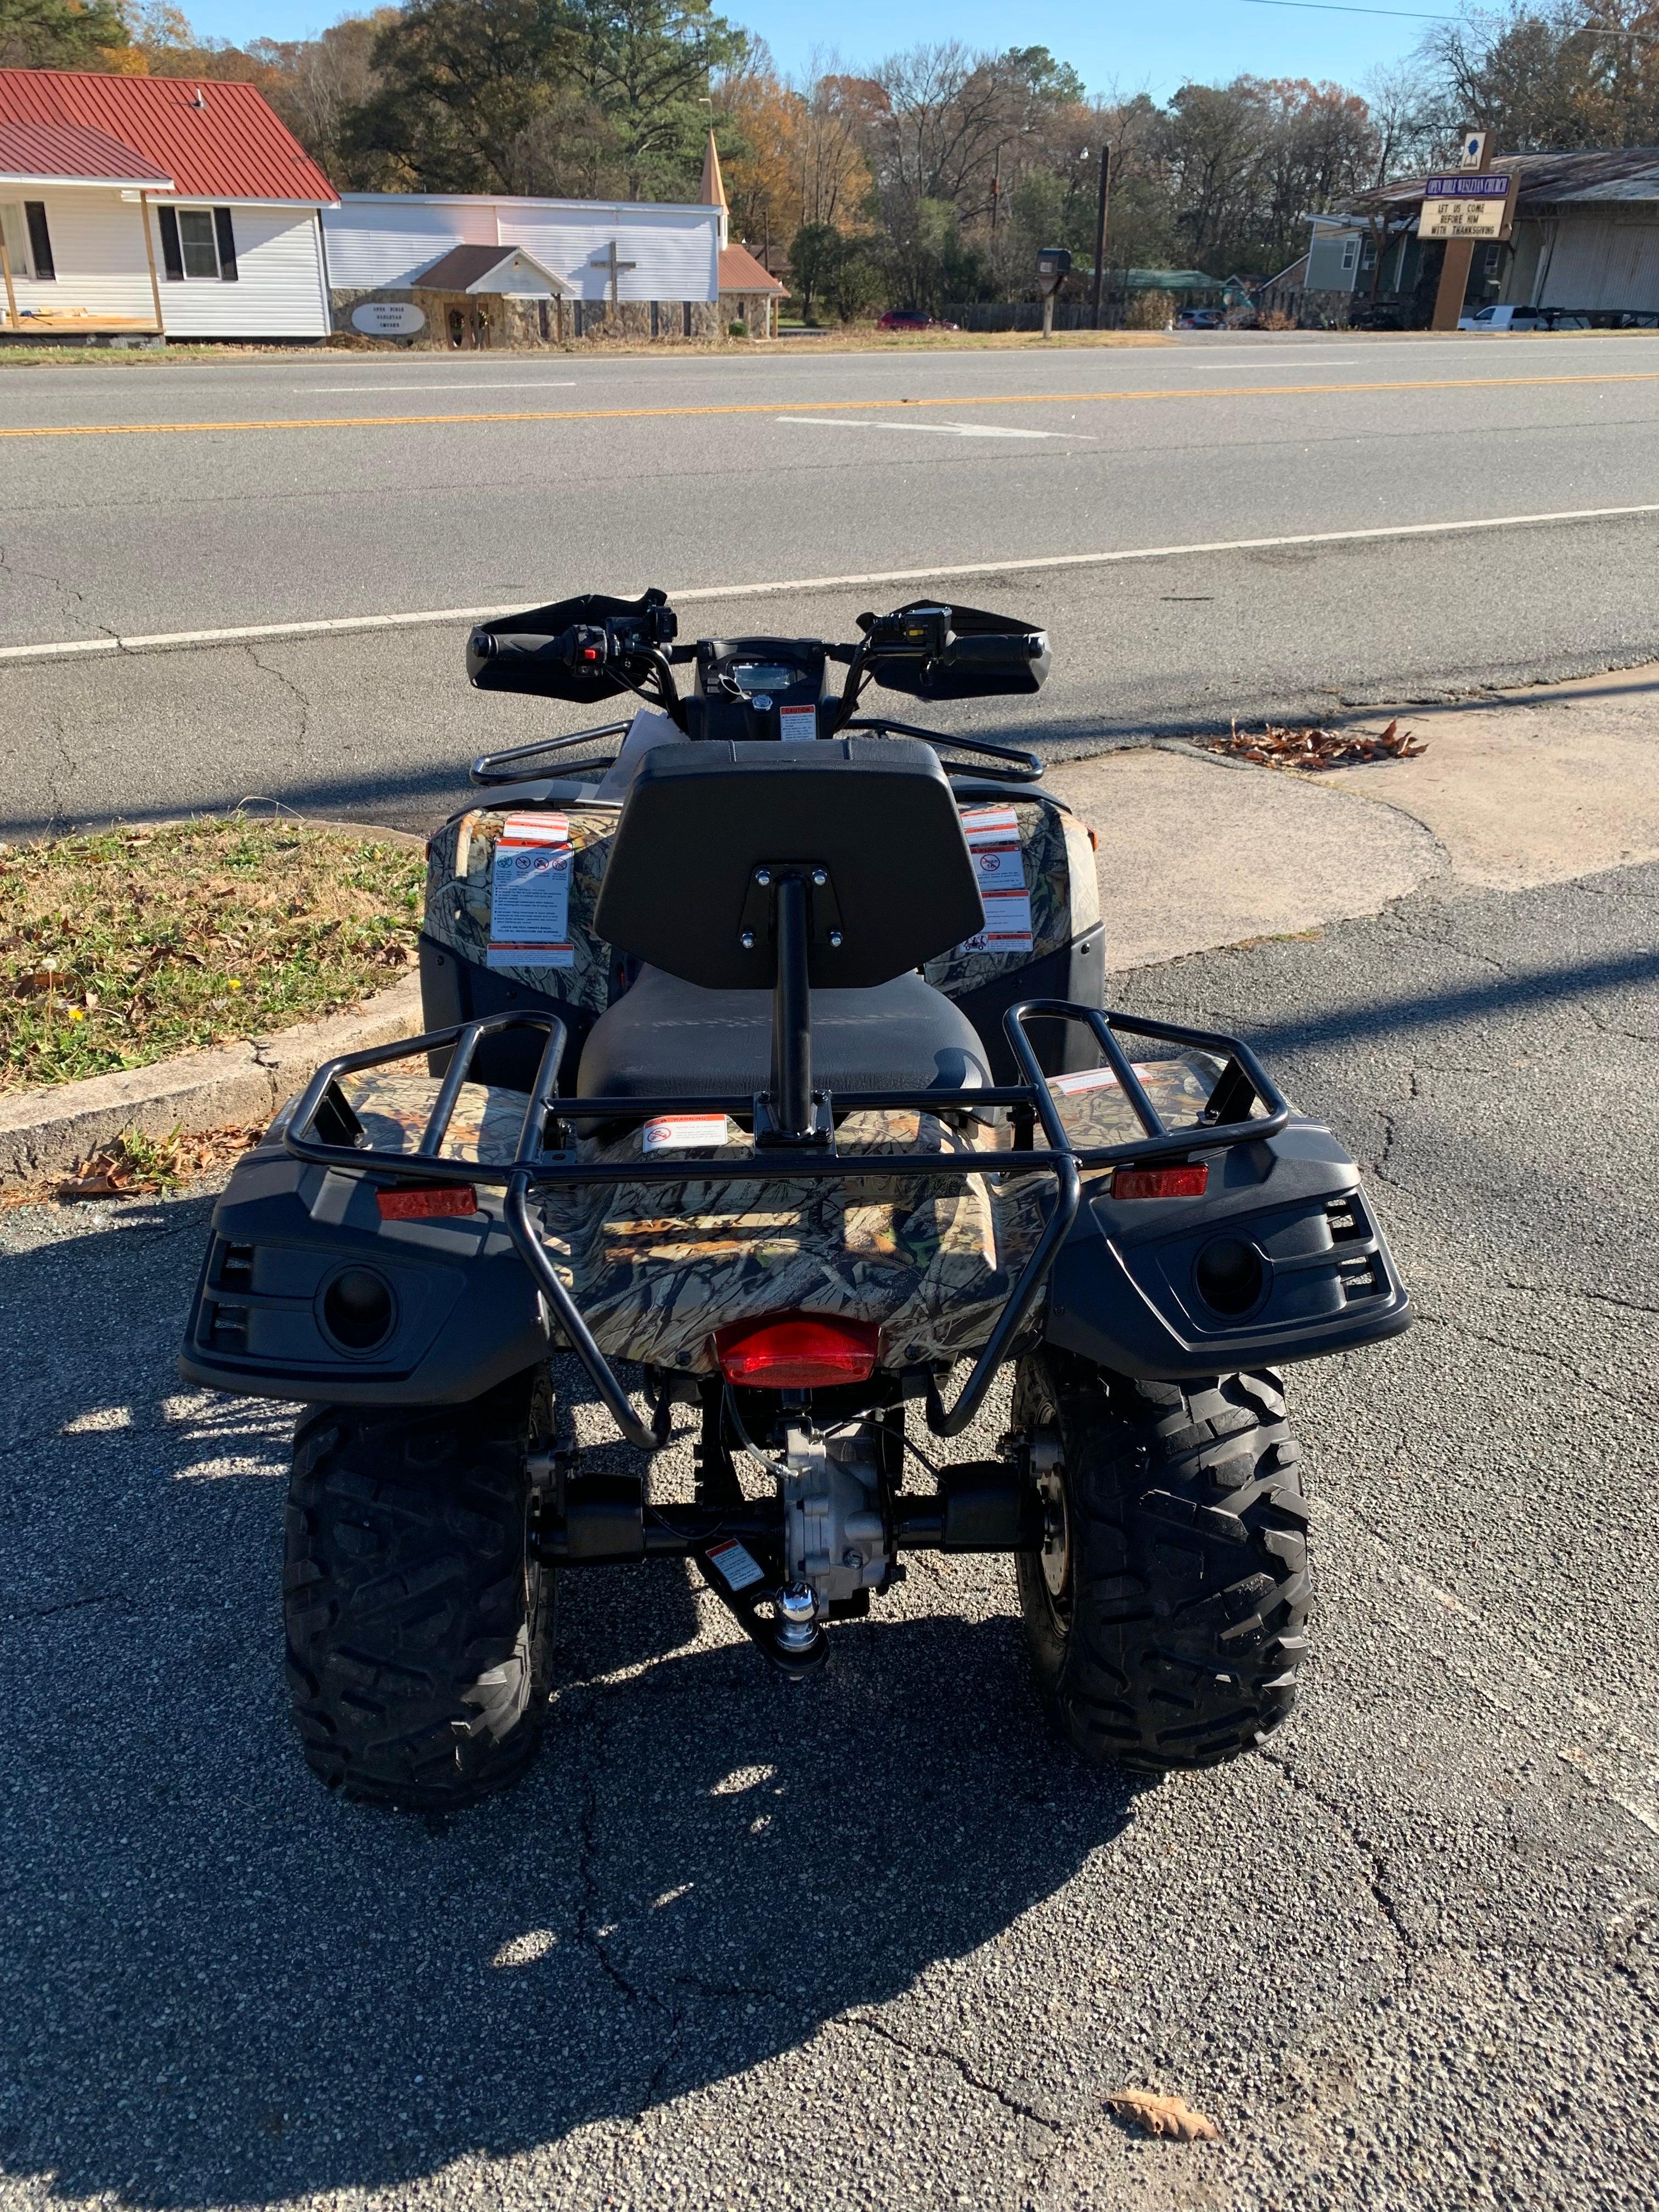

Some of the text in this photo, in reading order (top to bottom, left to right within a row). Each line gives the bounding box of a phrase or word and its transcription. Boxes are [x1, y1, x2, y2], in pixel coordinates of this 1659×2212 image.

[1484, 178, 1508, 193] CHURCH
[1438, 204, 1485, 213] LET US COME
[1440, 214, 1479, 224] BEFORE HIM
[1431, 225, 1494, 234] WITH THANKSGIVING
